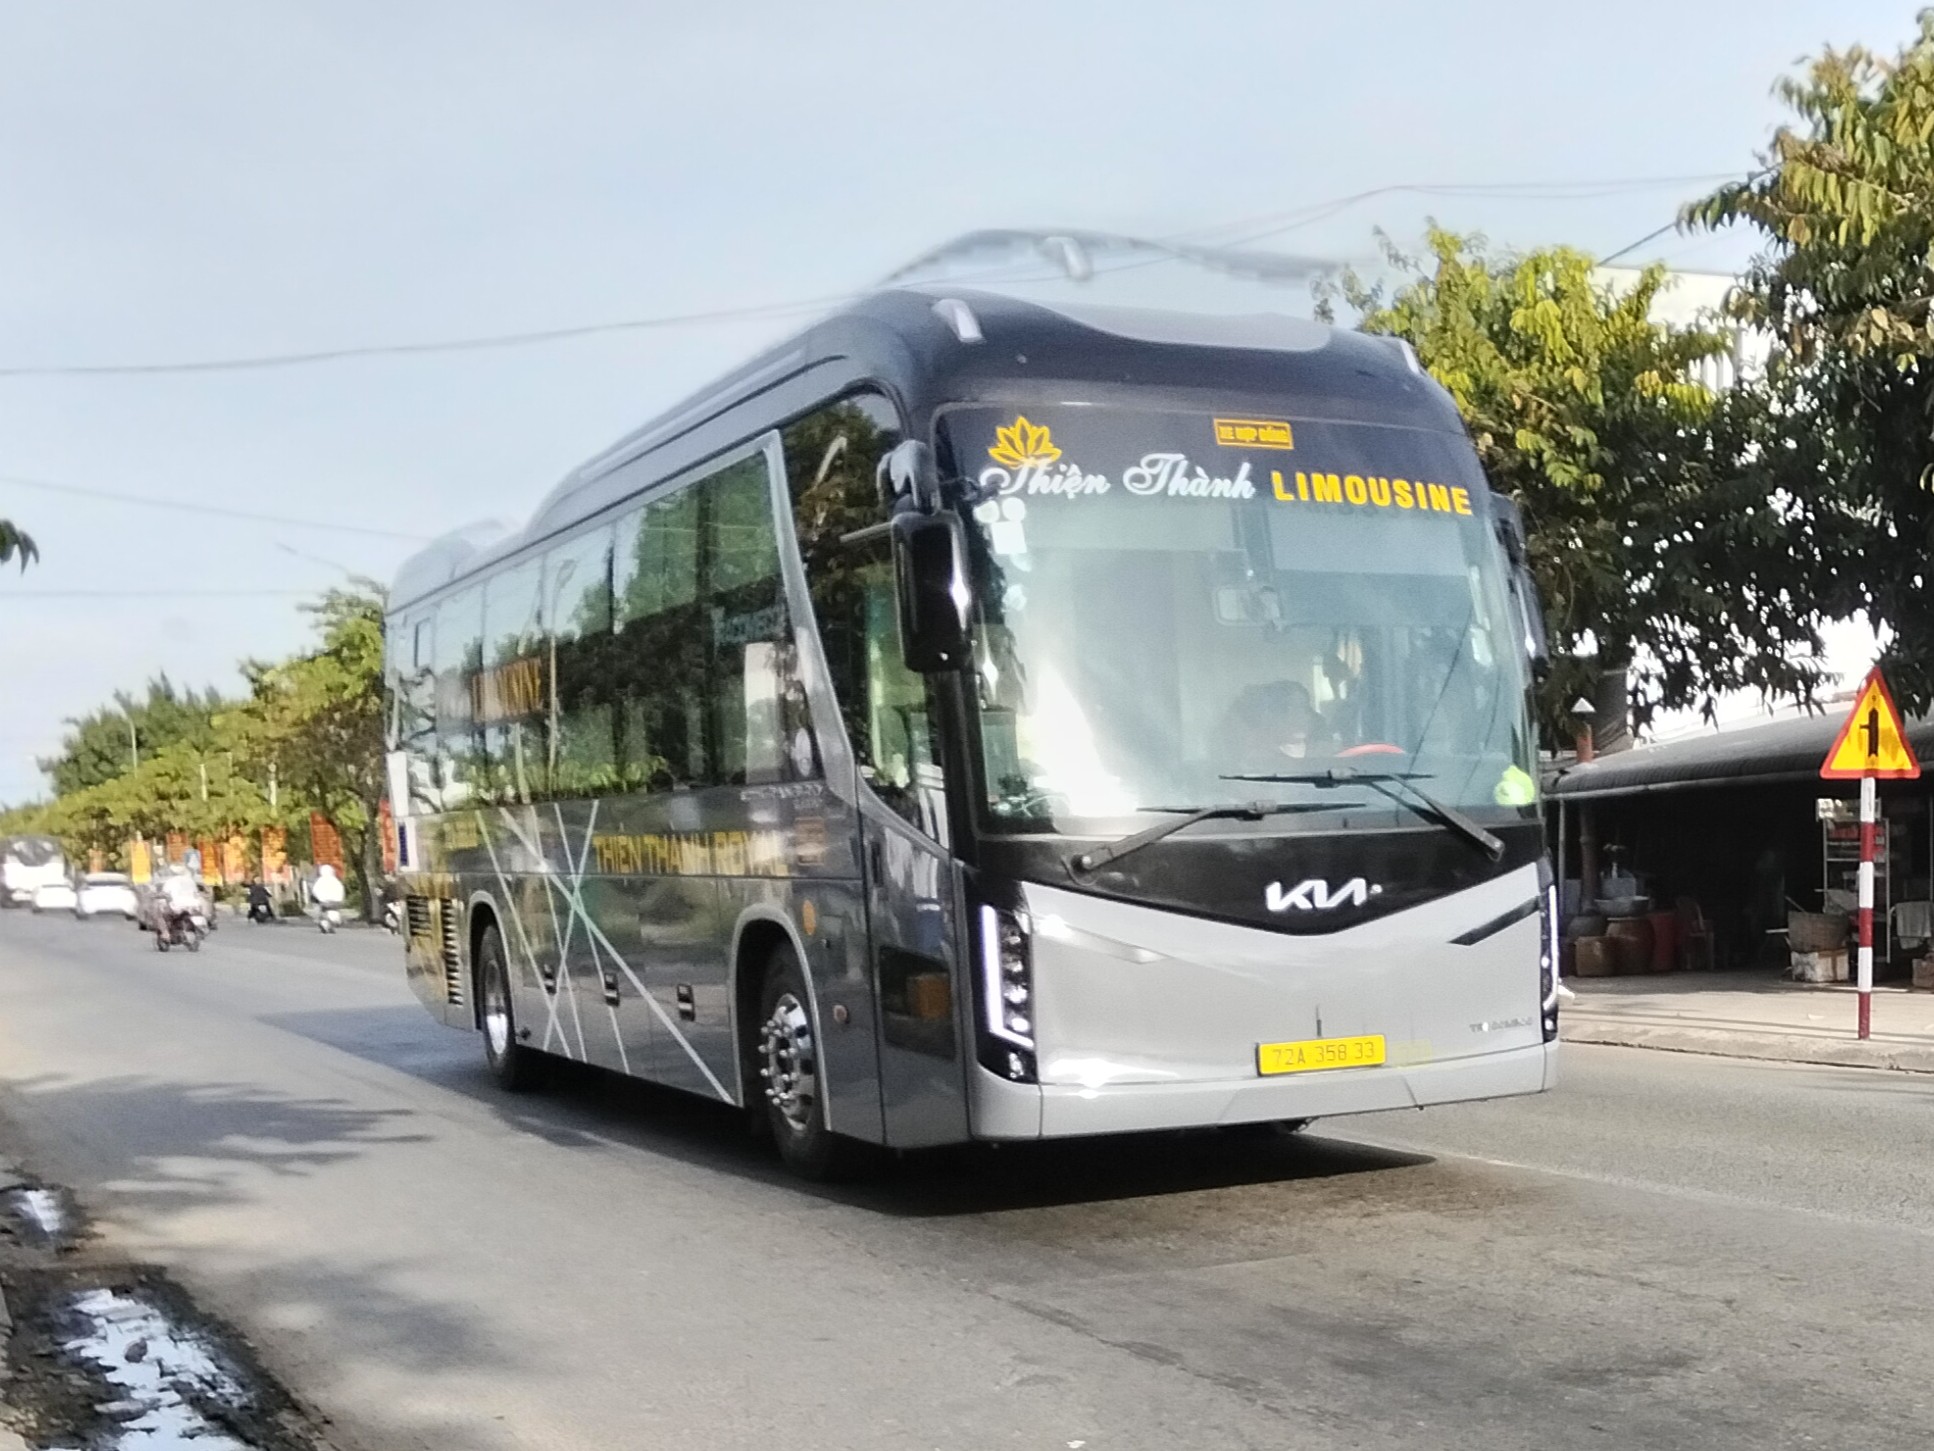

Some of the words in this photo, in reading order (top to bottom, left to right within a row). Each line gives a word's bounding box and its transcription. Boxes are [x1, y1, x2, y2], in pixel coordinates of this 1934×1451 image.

[979, 456, 1111, 500] Thiện
[1122, 452, 1257, 500] Thành
[1271, 470, 1473, 516] LIMOUSINE
[1272, 1047, 1306, 1067] 72A
[1314, 1043, 1348, 1063] 358
[1353, 1040, 1375, 1060] 33
